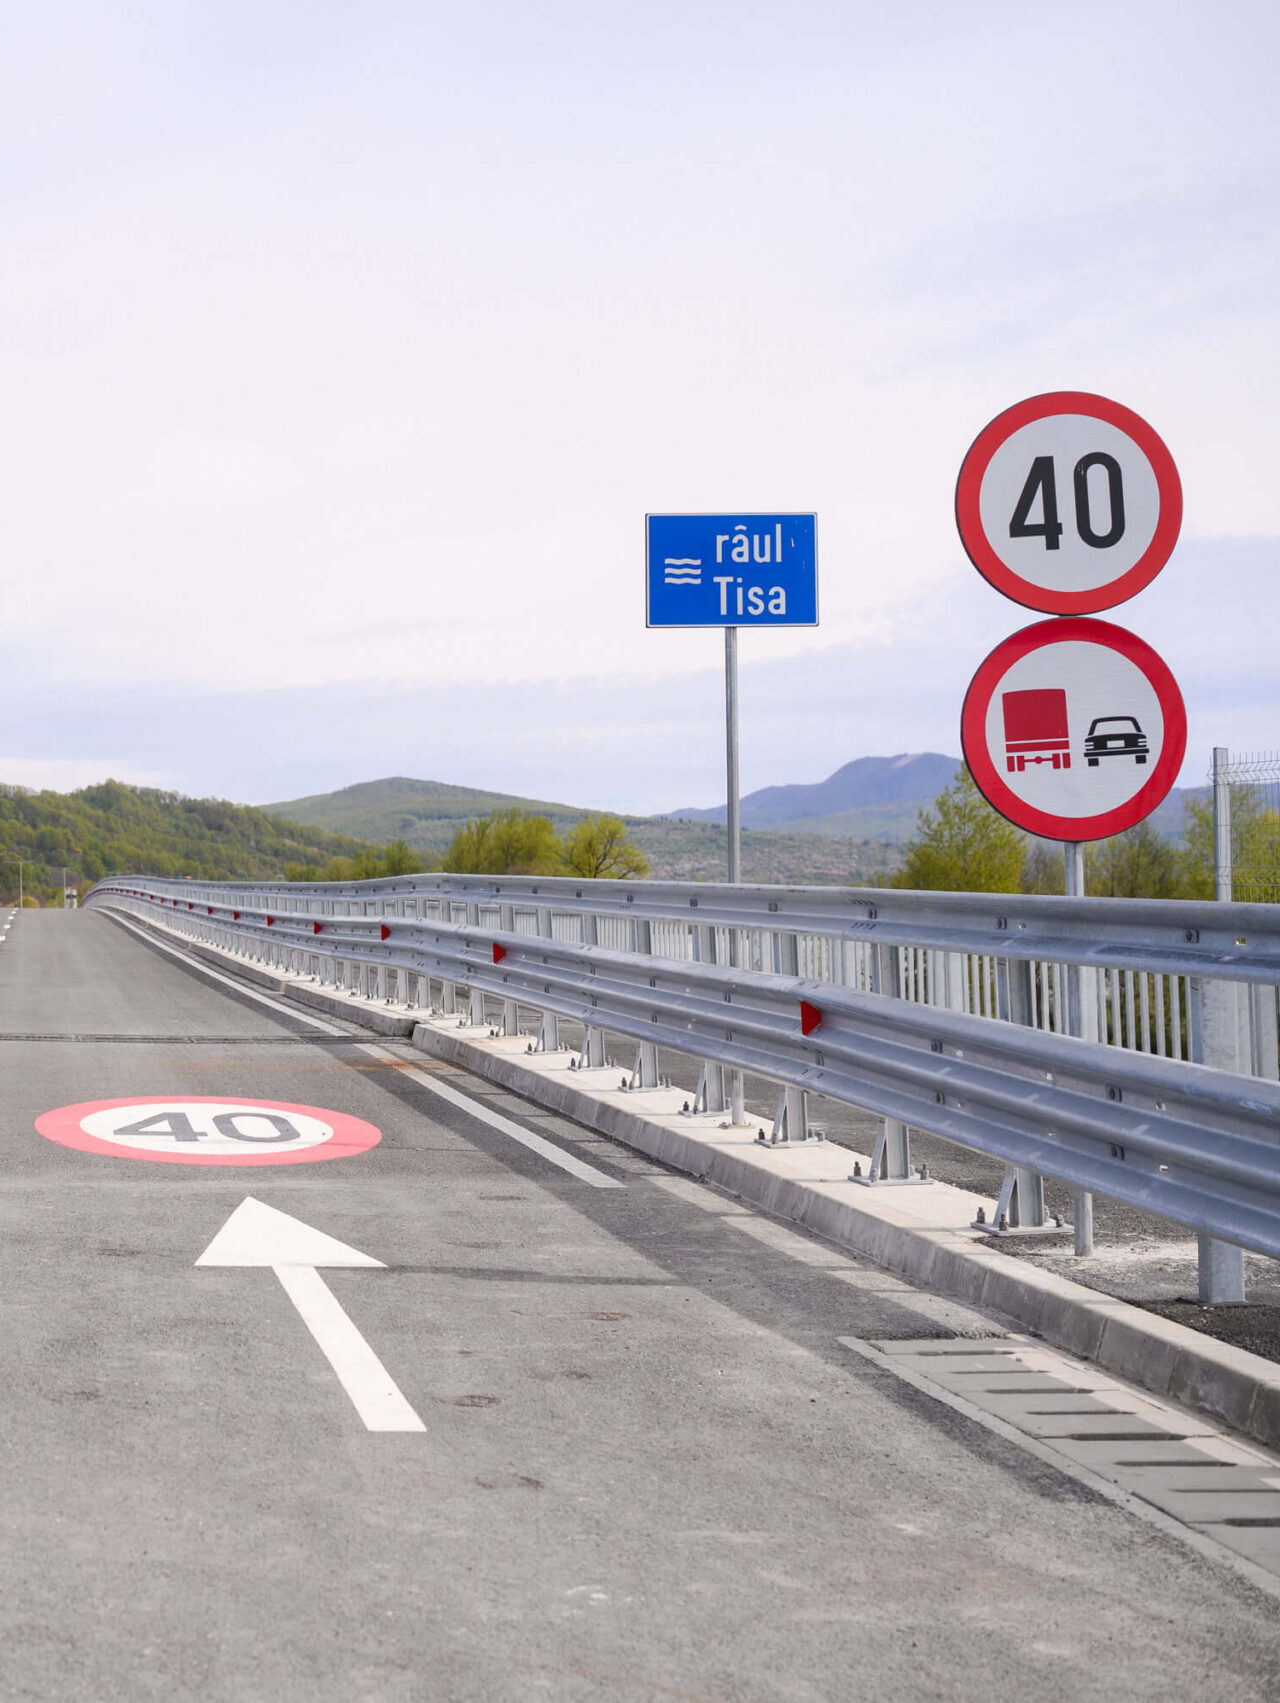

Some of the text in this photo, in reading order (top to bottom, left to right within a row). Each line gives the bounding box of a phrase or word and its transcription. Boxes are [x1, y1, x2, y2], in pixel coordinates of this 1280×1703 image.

[1008, 451, 1126, 551] 40
[715, 523, 782, 563] râul
[713, 576, 786, 616] Tisa
[113, 1112, 301, 1143] 40
